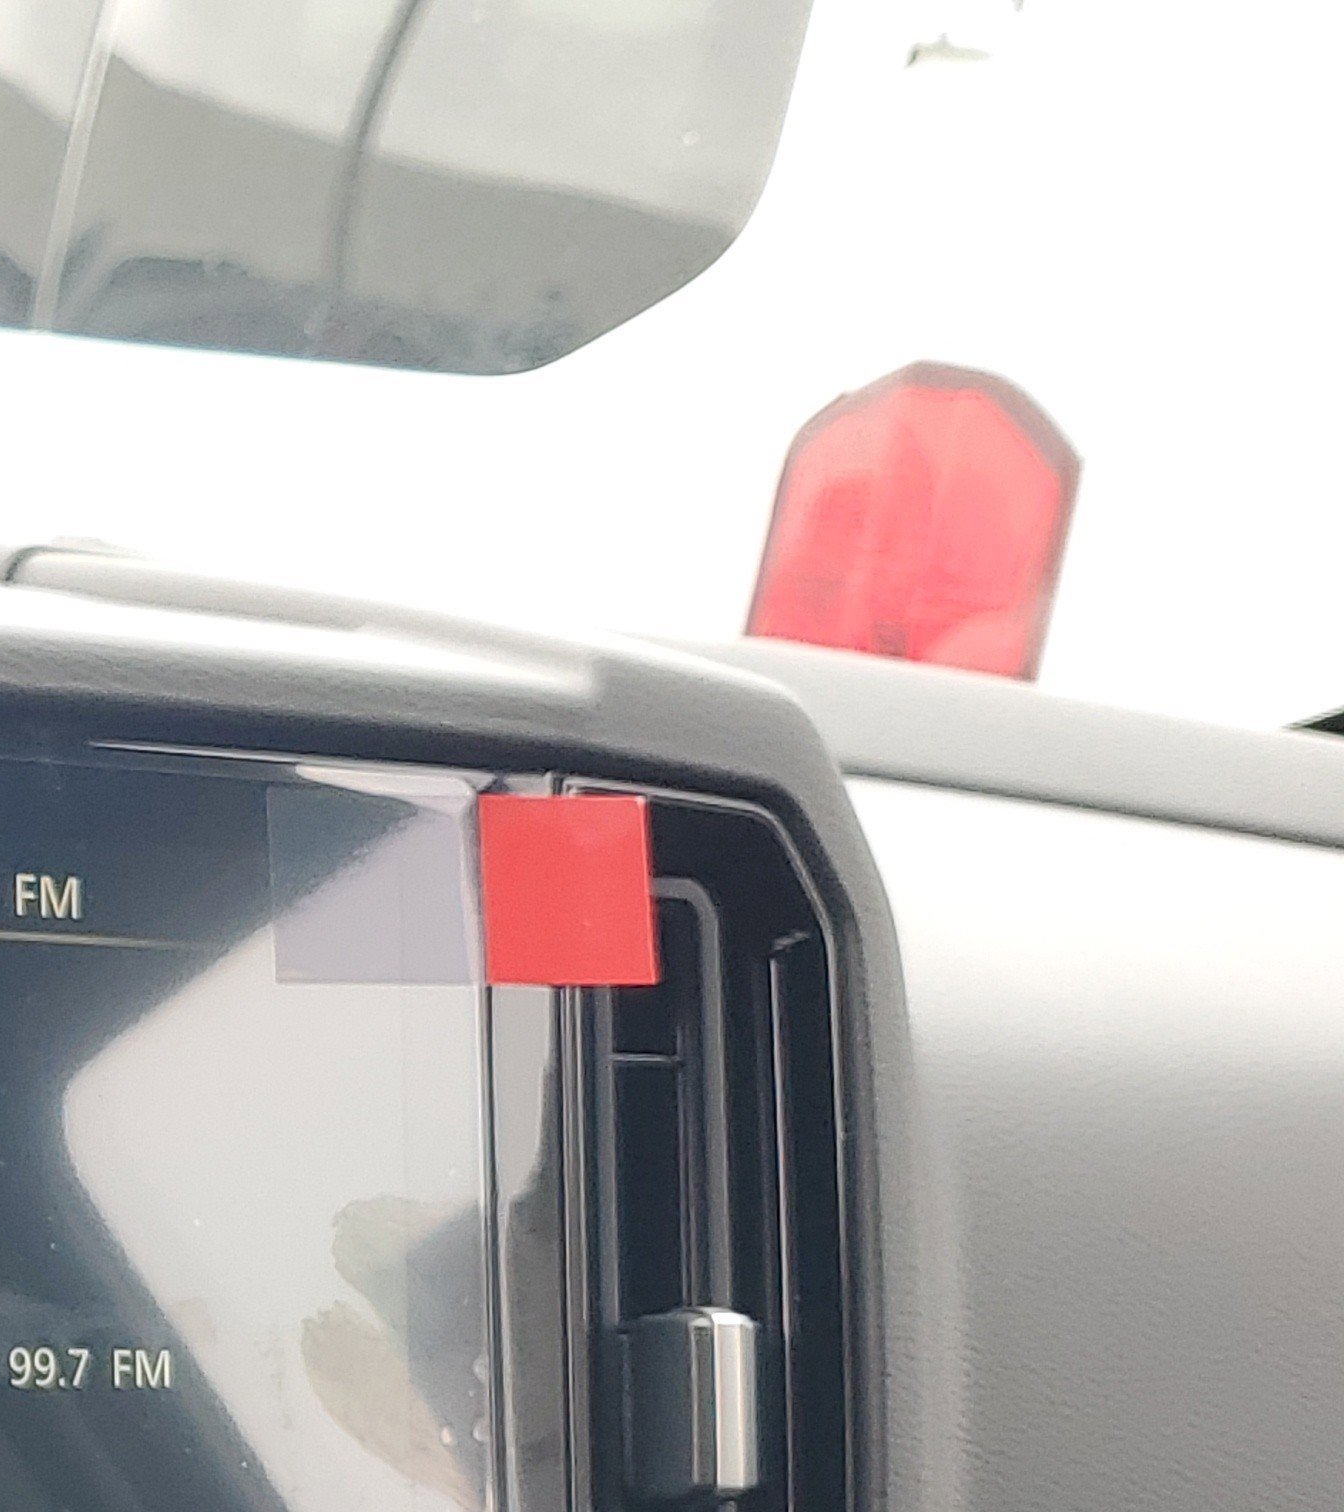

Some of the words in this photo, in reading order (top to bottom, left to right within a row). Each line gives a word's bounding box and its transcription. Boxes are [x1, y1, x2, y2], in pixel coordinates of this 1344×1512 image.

[14, 874, 82, 920] FM
[8, 1347, 91, 1389] 99.7
[113, 1349, 172, 1390] FM
